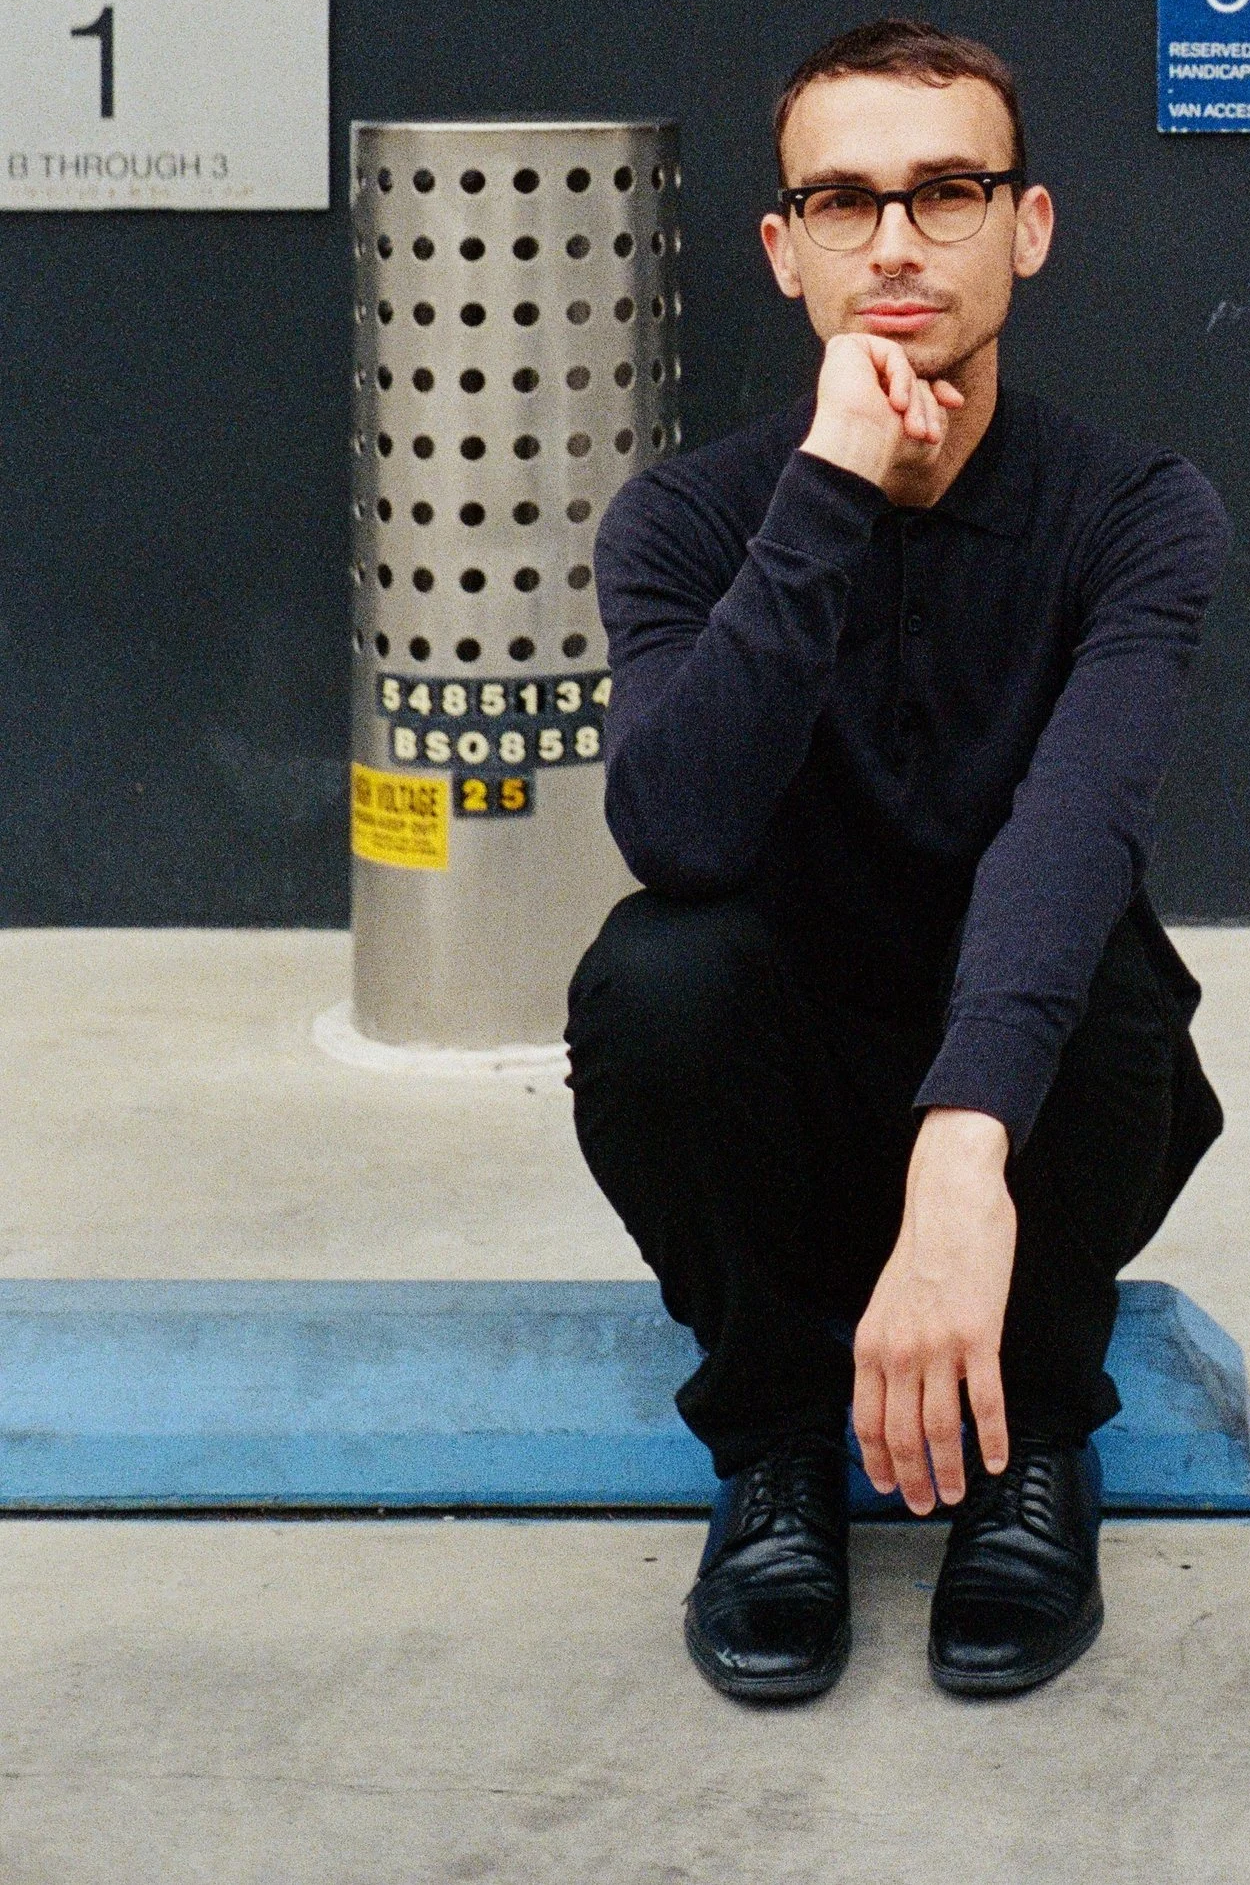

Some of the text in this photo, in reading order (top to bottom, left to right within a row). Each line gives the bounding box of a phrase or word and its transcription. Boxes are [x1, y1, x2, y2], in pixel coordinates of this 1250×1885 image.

[70, 5, 114, 119] 1
[1168, 102, 1200, 117] VAN
[7, 153, 229, 180] B THROUGH 3
